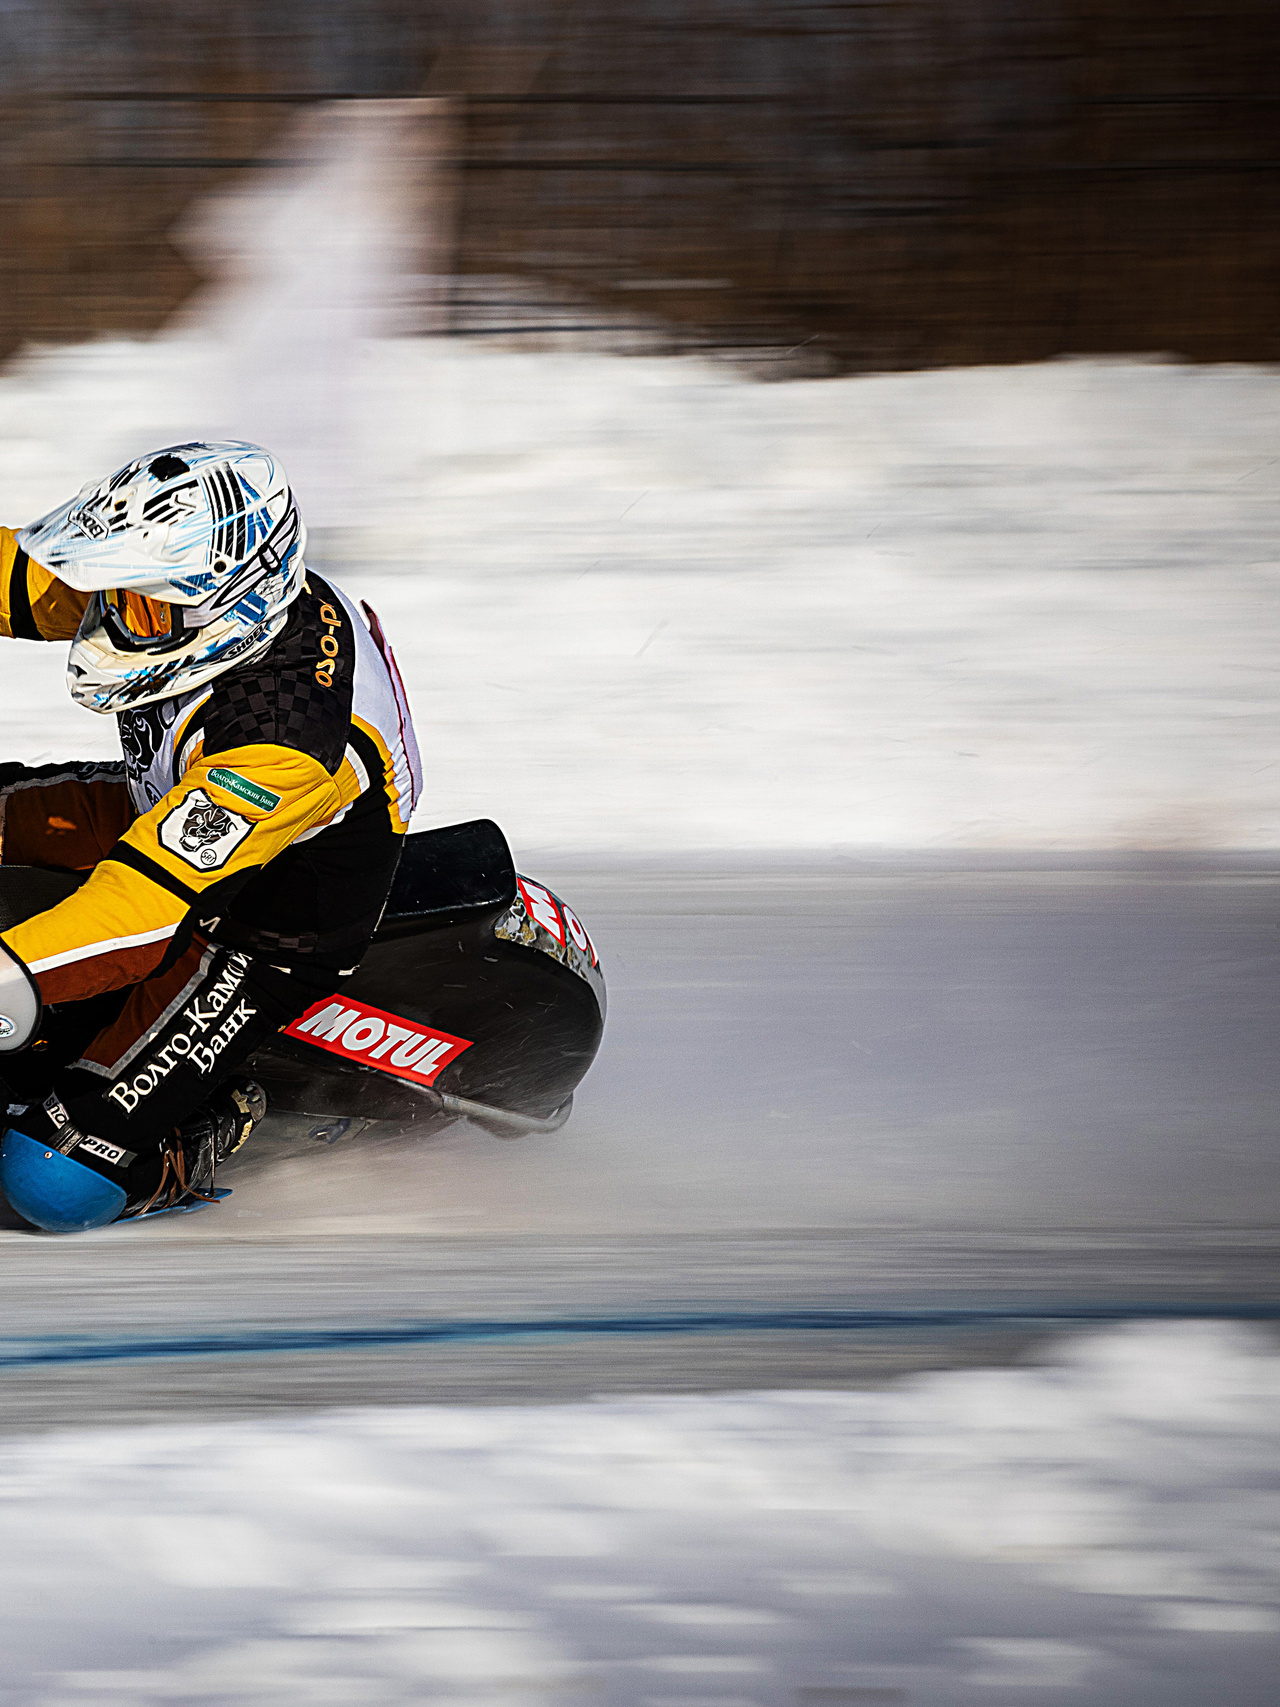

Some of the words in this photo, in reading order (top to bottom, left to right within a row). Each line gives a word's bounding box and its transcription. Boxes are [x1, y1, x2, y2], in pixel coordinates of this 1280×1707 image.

[227, 625, 263, 656] SHOEI
[186, 998, 257, 1074] Банк
[296, 1002, 455, 1076] MOTUL
[82, 1137, 120, 1160] PRO
